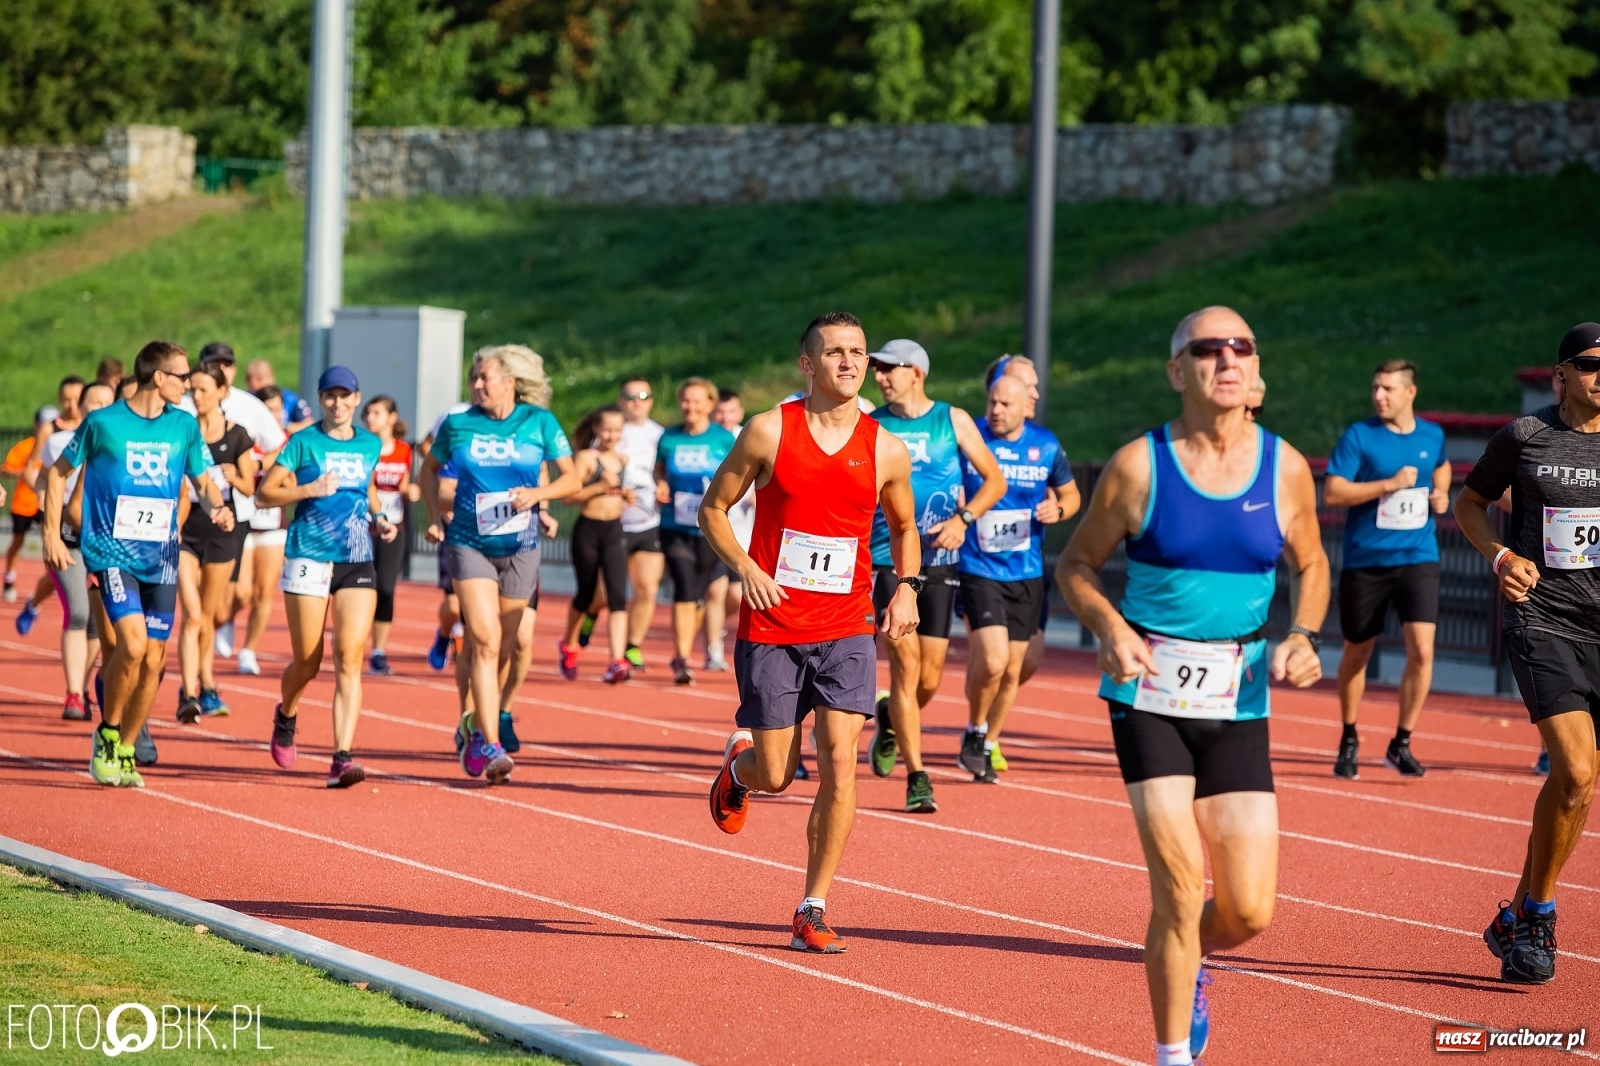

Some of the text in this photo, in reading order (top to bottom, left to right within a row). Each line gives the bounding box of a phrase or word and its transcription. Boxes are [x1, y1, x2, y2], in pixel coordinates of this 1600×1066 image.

[1399, 502, 1413, 514] 51
[137, 511, 154, 524] 72
[993, 523, 1018, 536] 154
[1574, 525, 1600, 547] 50
[810, 551, 832, 572] 11
[299, 564, 308, 577] 3
[1177, 665, 1208, 689] 97
